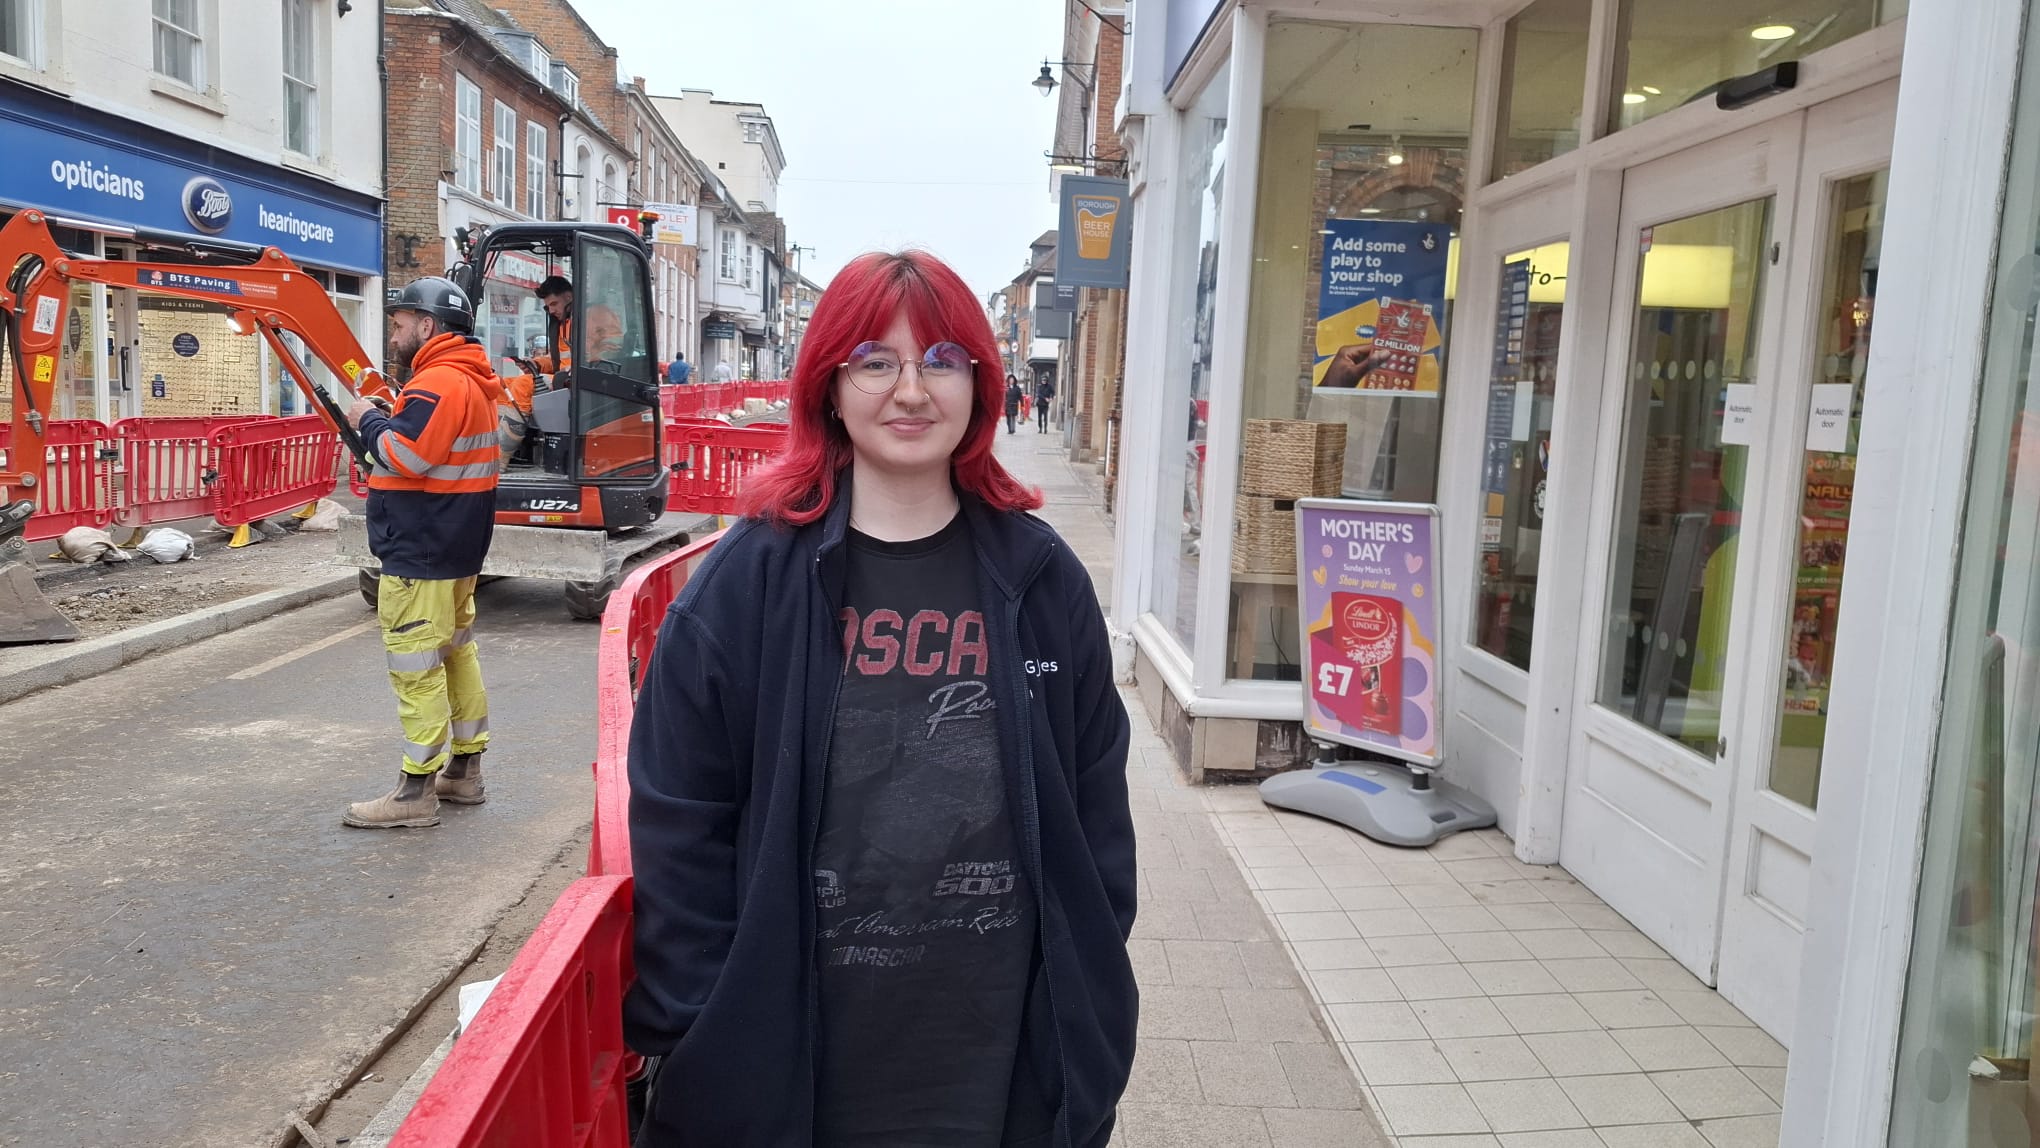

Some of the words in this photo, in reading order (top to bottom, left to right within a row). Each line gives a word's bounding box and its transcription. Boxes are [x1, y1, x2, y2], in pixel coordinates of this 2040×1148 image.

[51, 160, 144, 200] opticians
[197, 188, 231, 219] Boots
[1078, 200, 1115, 209] BOROUGH
[259, 204, 334, 243] hearingcare
[670, 213, 688, 224] LET
[1084, 220, 1110, 231] BEER
[1083, 230, 1109, 238] HOUSE
[1332, 237, 1363, 251] Add
[1365, 241, 1406, 253] some
[1330, 252, 1362, 270] play
[1365, 255, 1382, 267] to
[170, 274, 190, 283] BTS
[194, 276, 230, 290] Paving
[1330, 271, 1364, 284] your
[1367, 270, 1403, 286] shop
[1385, 341, 1420, 352] MILLION
[1816, 408, 1845, 416] Automatic
[530, 500, 578, 511] U27-4
[1321, 518, 1414, 544] MOTHER'S
[1348, 541, 1386, 562] DAY
[1343, 563, 1364, 574] Sunday
[1364, 566, 1383, 575] March
[1384, 568, 1392, 576] 15
[1338, 574, 1358, 586] Show
[1361, 580, 1379, 590] your
[1380, 579, 1398, 592] love
[1352, 620, 1380, 632] LINDOR
[1318, 662, 1354, 696] £7
[943, 860, 1010, 876] DAYTONA
[932, 874, 1016, 896] 500
